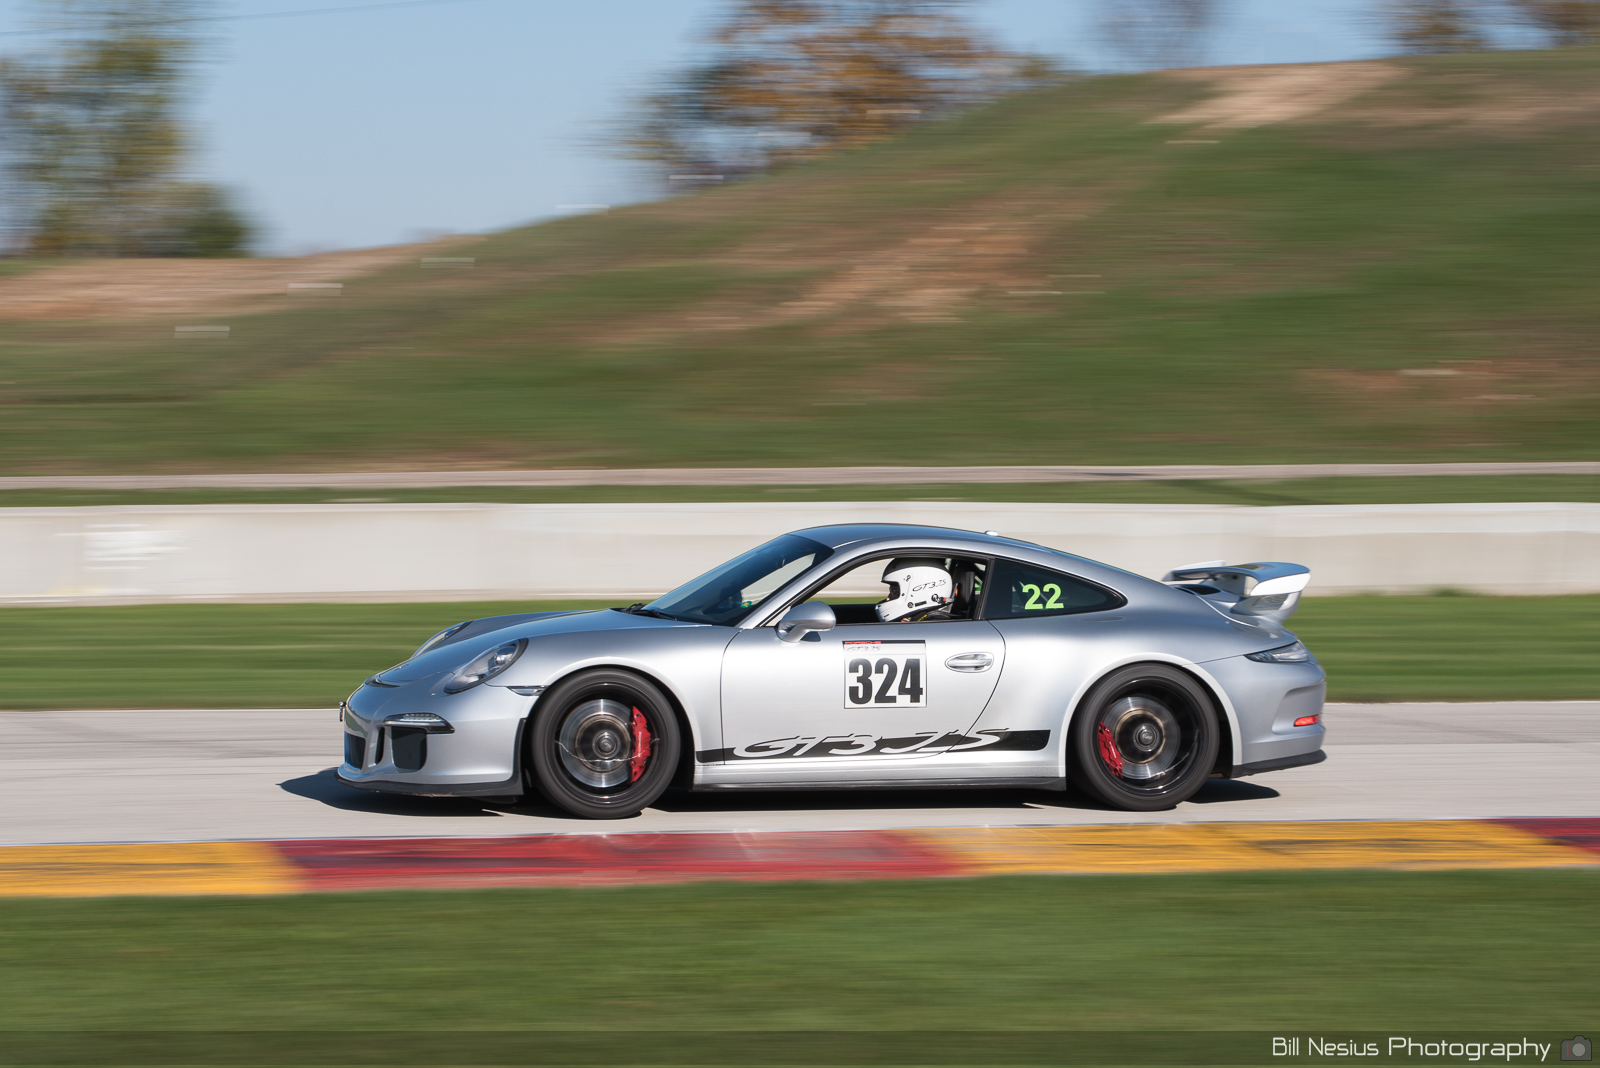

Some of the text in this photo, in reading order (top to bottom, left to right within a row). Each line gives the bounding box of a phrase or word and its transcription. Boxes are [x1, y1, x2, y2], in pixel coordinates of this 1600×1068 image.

[1022, 583, 1065, 610] 22
[848, 657, 924, 705] 324
[733, 733, 883, 757] GT3
